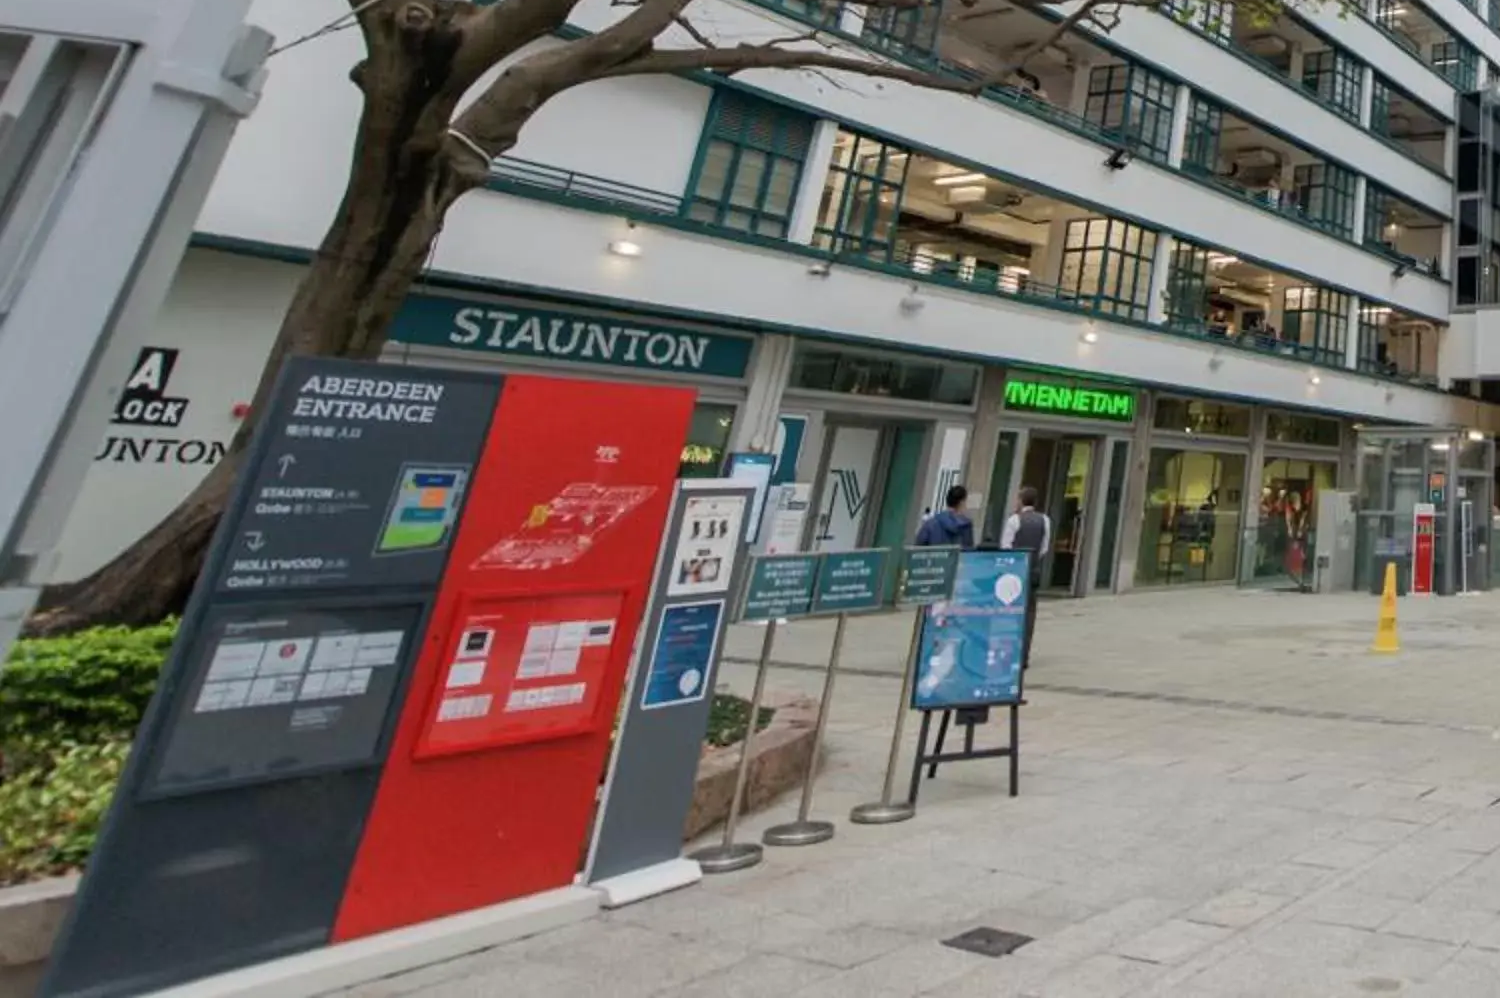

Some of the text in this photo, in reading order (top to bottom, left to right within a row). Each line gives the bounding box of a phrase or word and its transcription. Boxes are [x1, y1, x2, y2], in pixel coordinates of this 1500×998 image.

[449, 307, 710, 369] STAUNTON
[127, 351, 165, 391] A
[301, 375, 445, 402] ABERDEEN
[113, 399, 183, 424] OCK
[293, 398, 437, 424] ENTRANCE
[261, 487, 334, 499] STAUNTON
[233, 557, 324, 572] HOLLYWOOD
